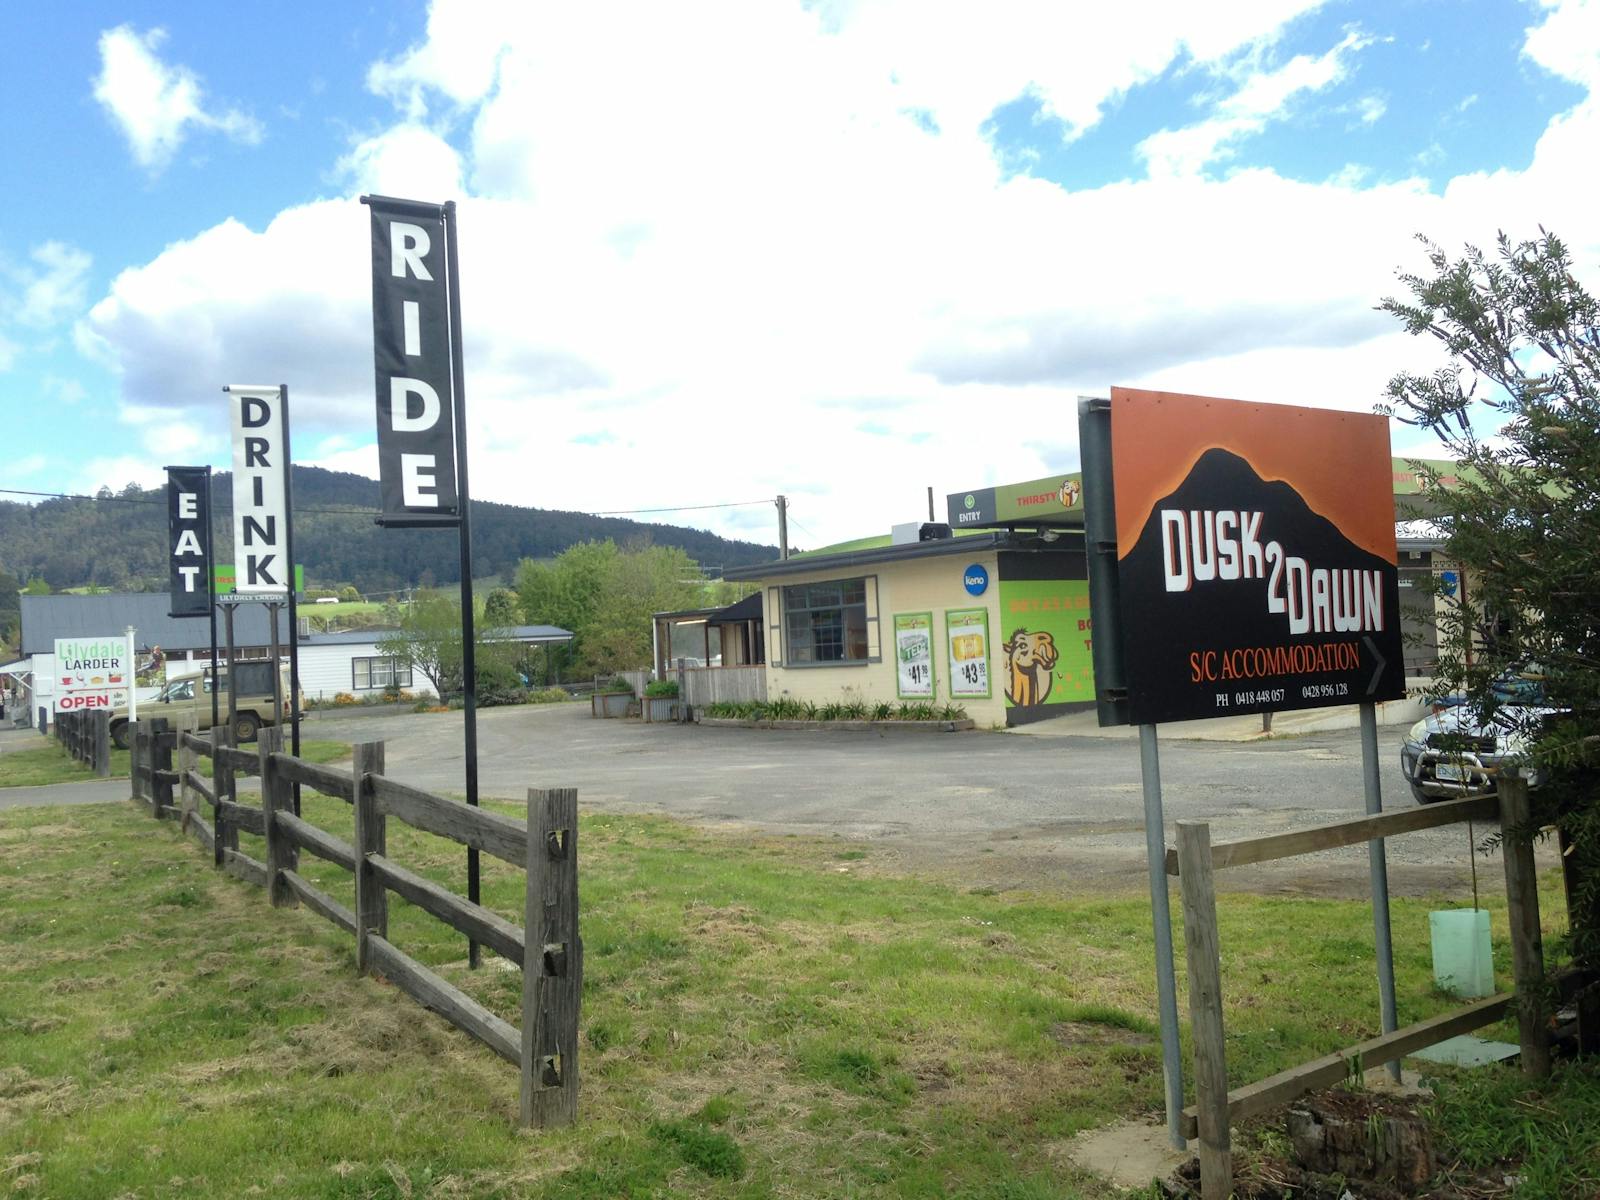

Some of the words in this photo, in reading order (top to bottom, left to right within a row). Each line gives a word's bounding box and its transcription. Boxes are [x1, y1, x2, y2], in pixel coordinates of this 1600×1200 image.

[390, 221, 441, 508] RIDE
[241, 397, 278, 586] DRINK
[1017, 492, 1057, 507] THIRSTY
[959, 511, 980, 522] ENTRY
[175, 493, 203, 593] EAT
[1161, 509, 1266, 592] DUSK
[1285, 556, 1384, 635] DAWN
[59, 641, 124, 661] Lilydale
[1190, 651, 1217, 682] S/C
[1221, 642, 1360, 680] ACCOMMODATION
[65, 658, 119, 670] LARDER
[60, 695, 109, 708] OPEN
[1216, 693, 1229, 707] PH
[1235, 690, 1255, 705] 0418
[1256, 689, 1270, 703] 448
[1271, 688, 1285, 702] 057
[1302, 684, 1320, 698] 0428
[1320, 683, 1334, 696] 956
[1336, 682, 1348, 695] 128
